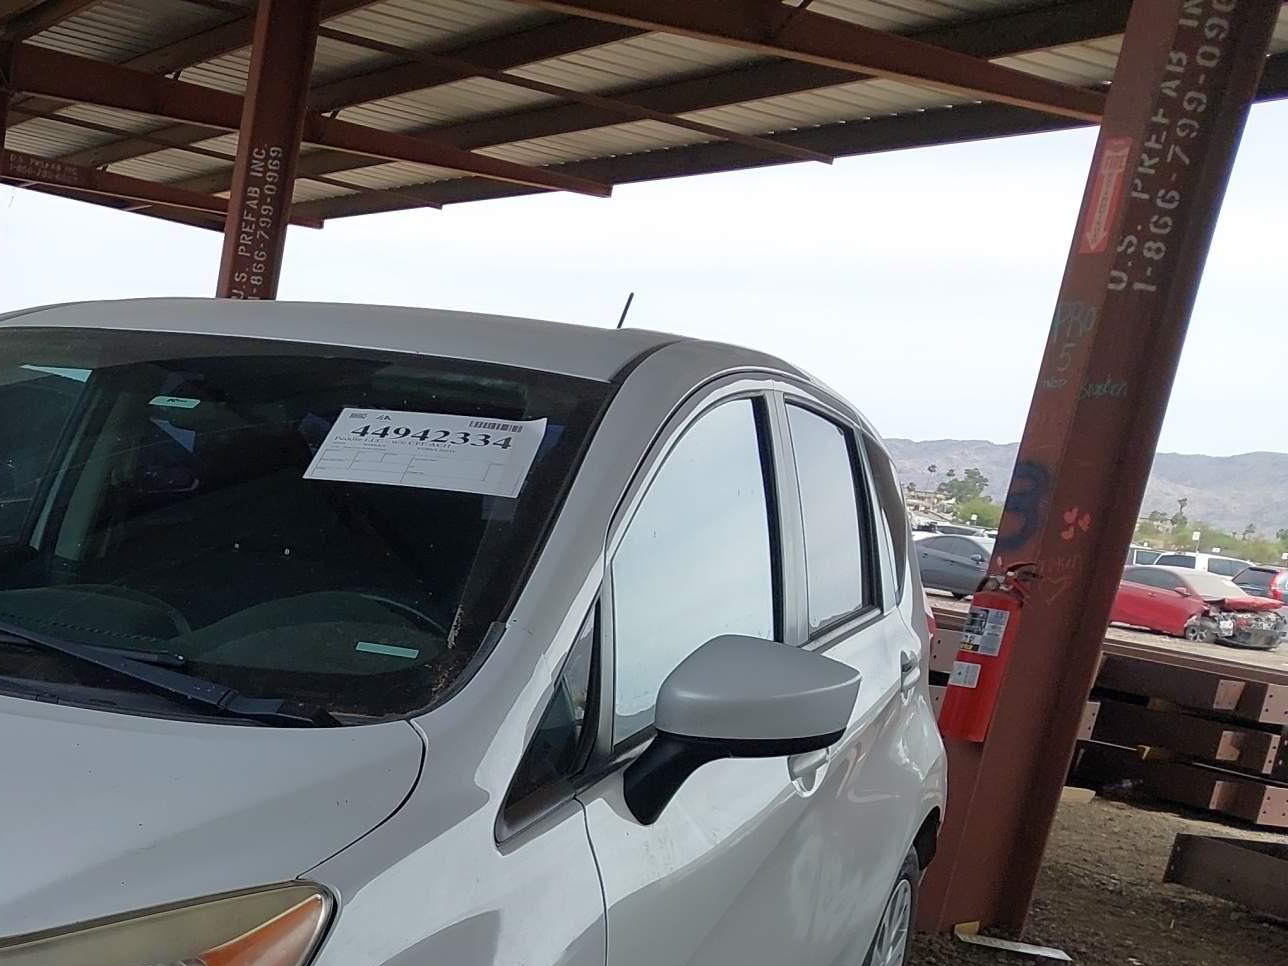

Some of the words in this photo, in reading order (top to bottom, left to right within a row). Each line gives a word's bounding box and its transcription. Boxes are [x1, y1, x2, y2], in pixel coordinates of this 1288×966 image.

[1108, 225, 1142, 290] U.S.
[1132, 51, 1187, 199] PREFAB
[238, 186, 261, 257] PREFAB
[351, 424, 513, 450] 44942334
